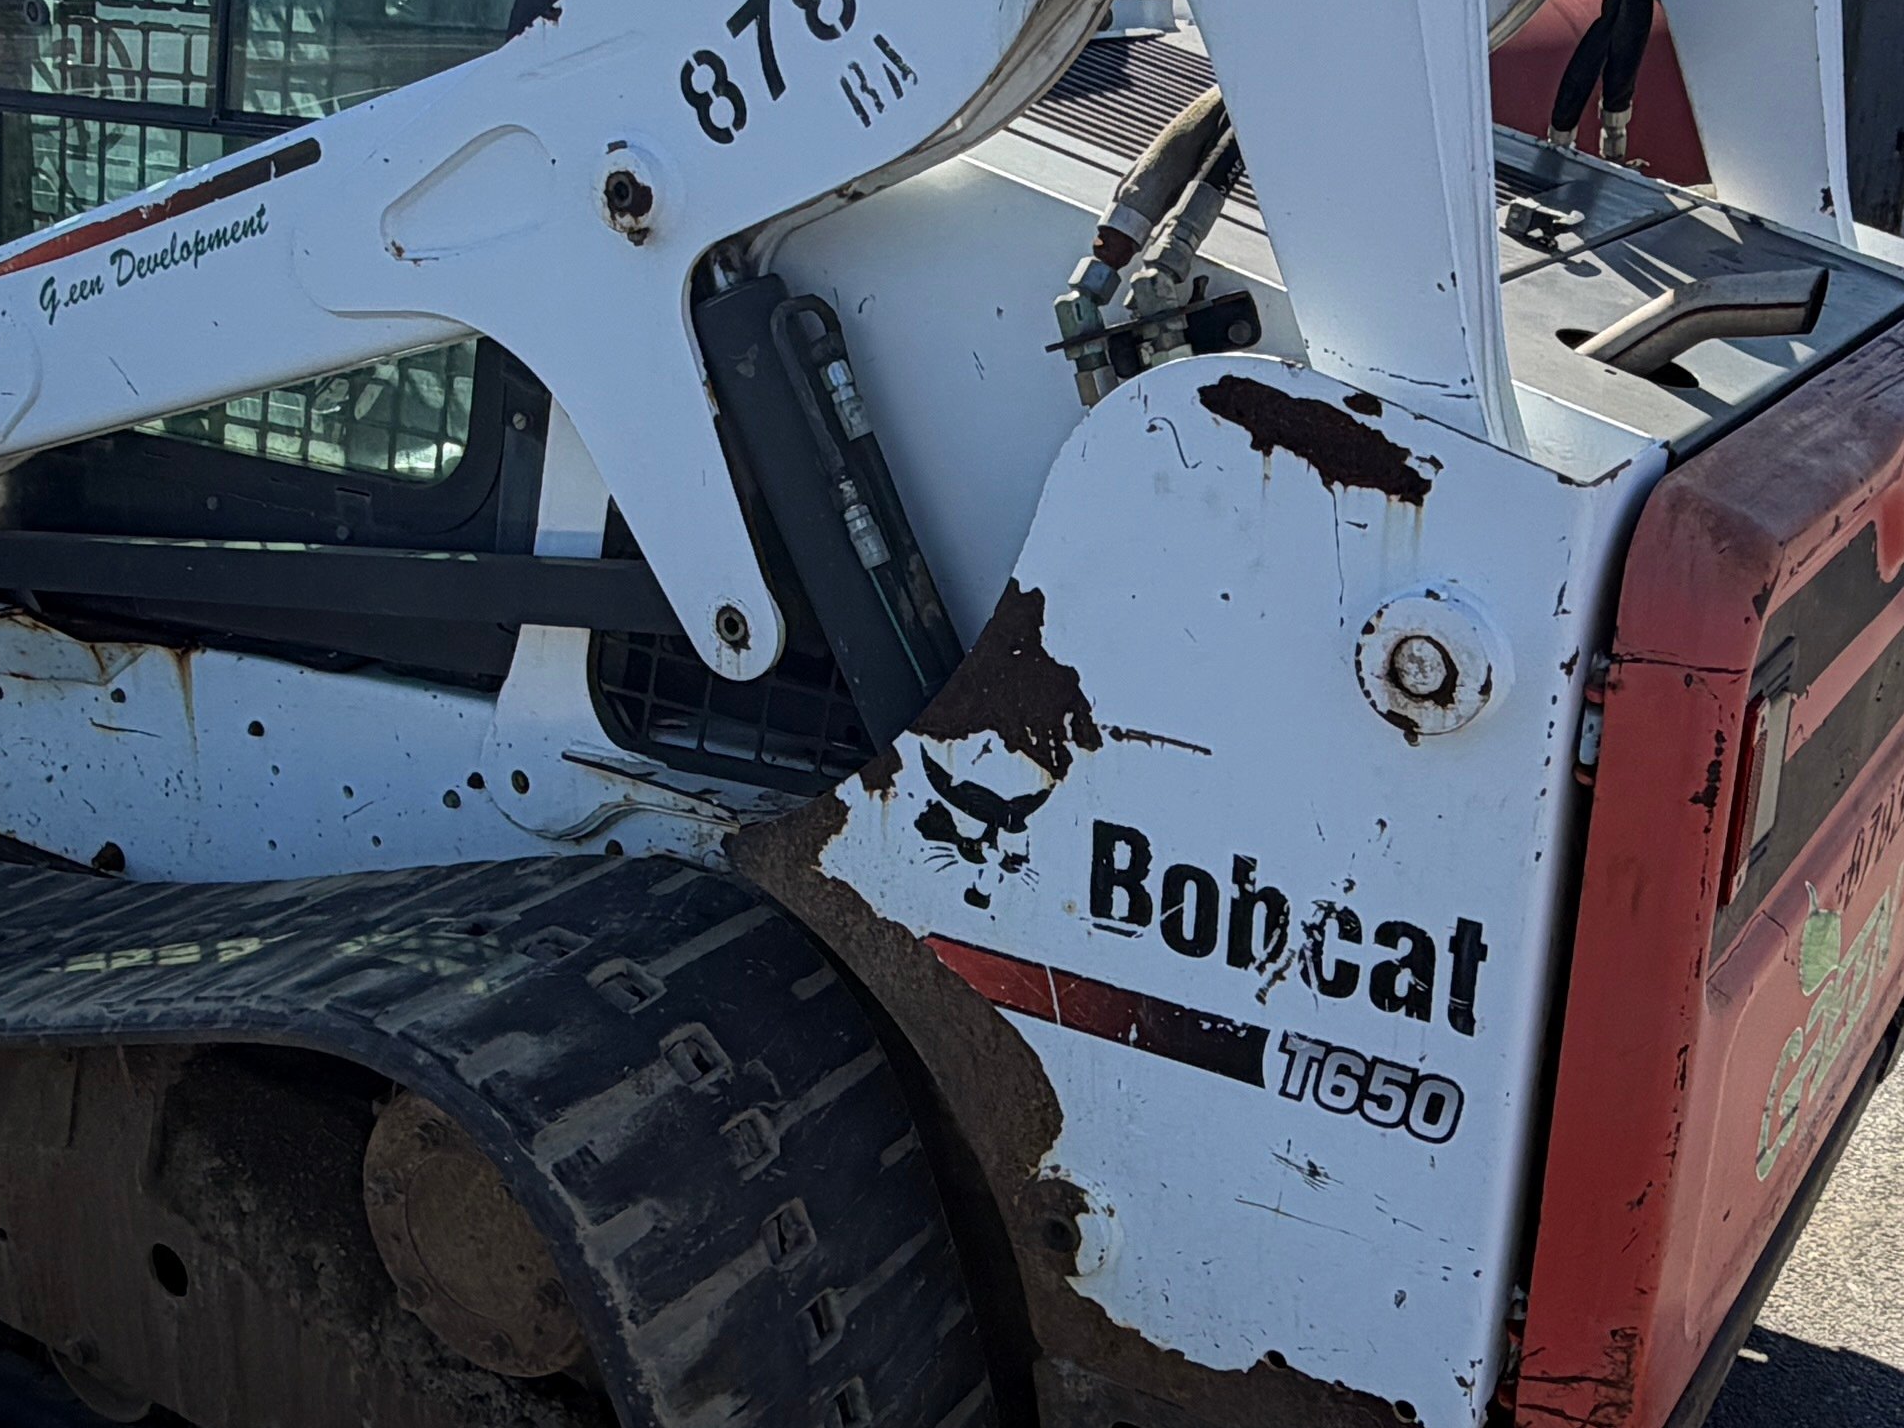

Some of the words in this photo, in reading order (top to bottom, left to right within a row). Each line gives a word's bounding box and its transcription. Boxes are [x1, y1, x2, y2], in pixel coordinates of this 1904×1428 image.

[110, 203, 269, 287] Development
[1091, 819, 1488, 1037] Bobcat
[1278, 1029, 1465, 1144] T650
